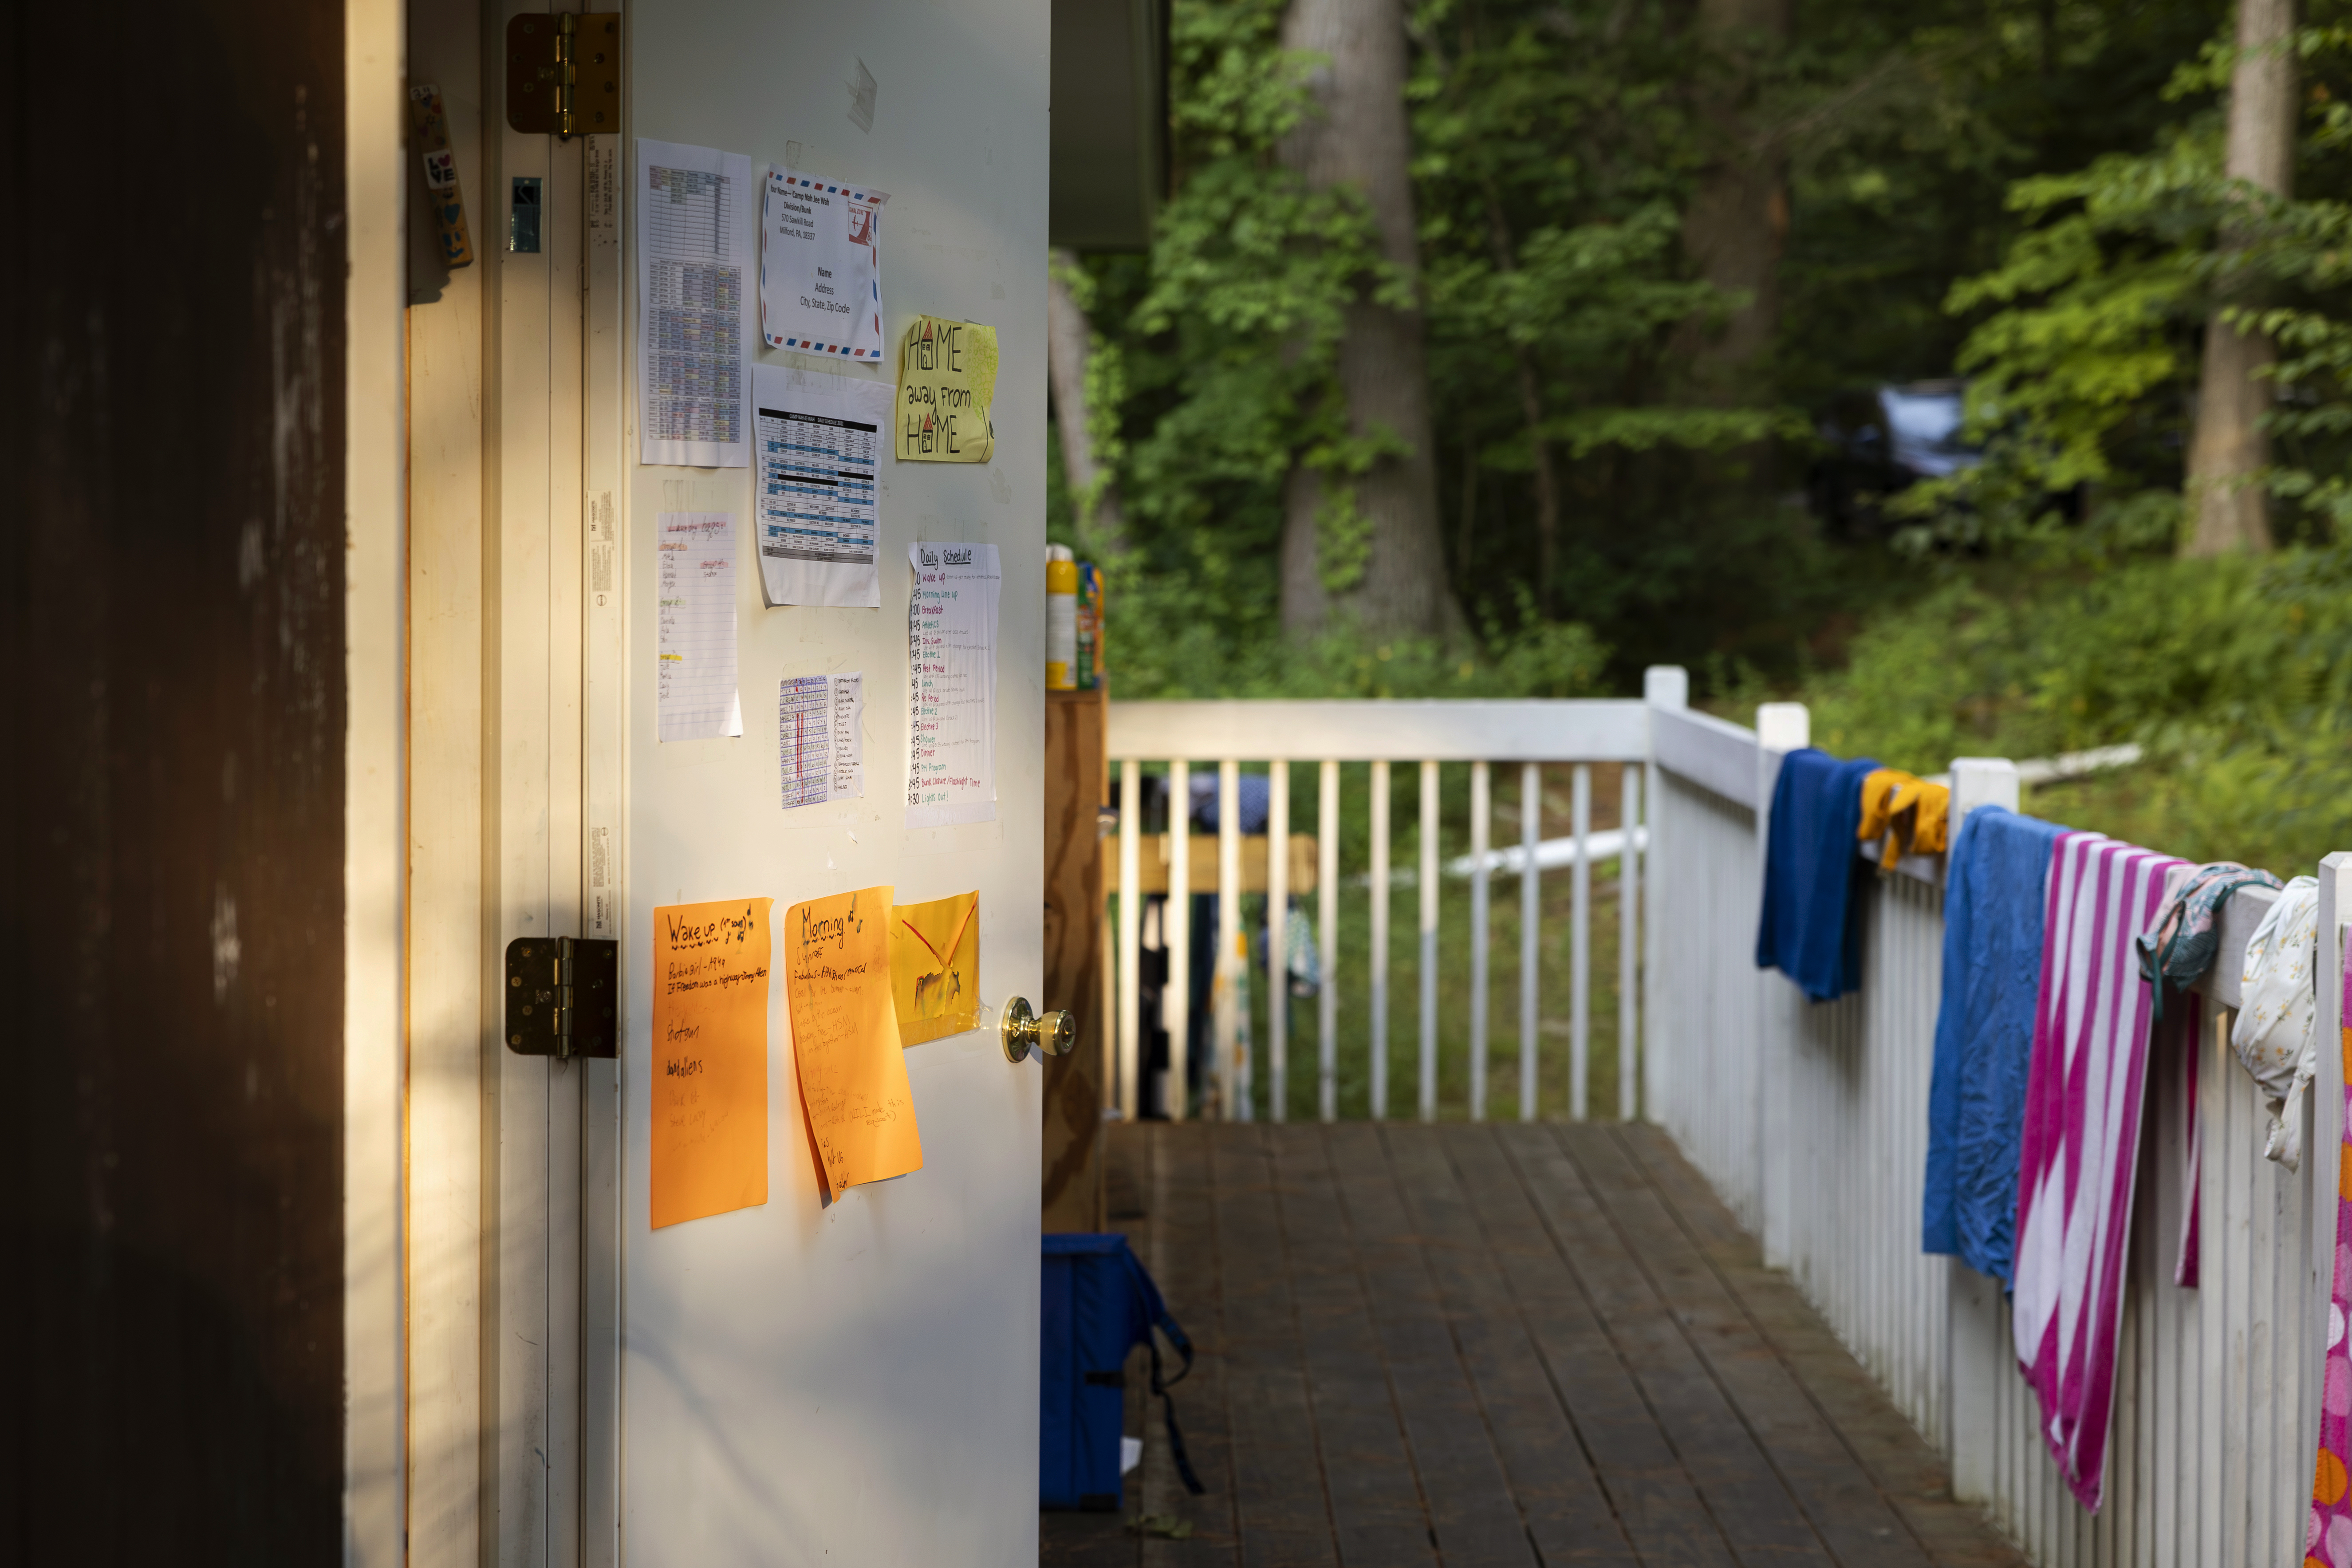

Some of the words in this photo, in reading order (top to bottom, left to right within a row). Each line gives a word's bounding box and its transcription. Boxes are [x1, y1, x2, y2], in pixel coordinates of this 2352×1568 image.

[792, 190, 804, 200] Camp
[804, 193, 813, 202] Nah
[821, 197, 830, 206] Wah
[784, 201, 812, 215] Division/Bunk
[804, 219, 814, 228] Road
[780, 226, 795, 238] Milford,
[803, 231, 815, 240] 18337
[818, 266, 832, 278] Name
[815, 282, 834, 295] Address
[800, 296, 811, 309] City,
[812, 298, 826, 311] State,
[835, 303, 850, 314] Code
[906, 385, 937, 426] away
[920, 548, 938, 571] Daily
[943, 548, 971, 563] Schedule
[939, 572, 946, 585] up
[922, 591, 940, 604] Morning
[952, 591, 958, 601] up
[922, 604, 943, 615] Breakfast
[933, 664, 945, 674] Period
[922, 679, 933, 688] Lunch
[928, 693, 939, 703] Period
[920, 734, 936, 743] Shower
[921, 749, 935, 757] Dinner
[921, 764, 927, 772] PM
[929, 763, 946, 775] Program
[921, 778, 932, 788] Bunk
[922, 793, 936, 806] Lights
[938, 790, 948, 802] Out!
[667, 914, 702, 942] Wake
[704, 923, 716, 937] up
[802, 906, 844, 949] Morning
[699, 980, 712, 989] was
[888, 1098, 904, 1108] this
